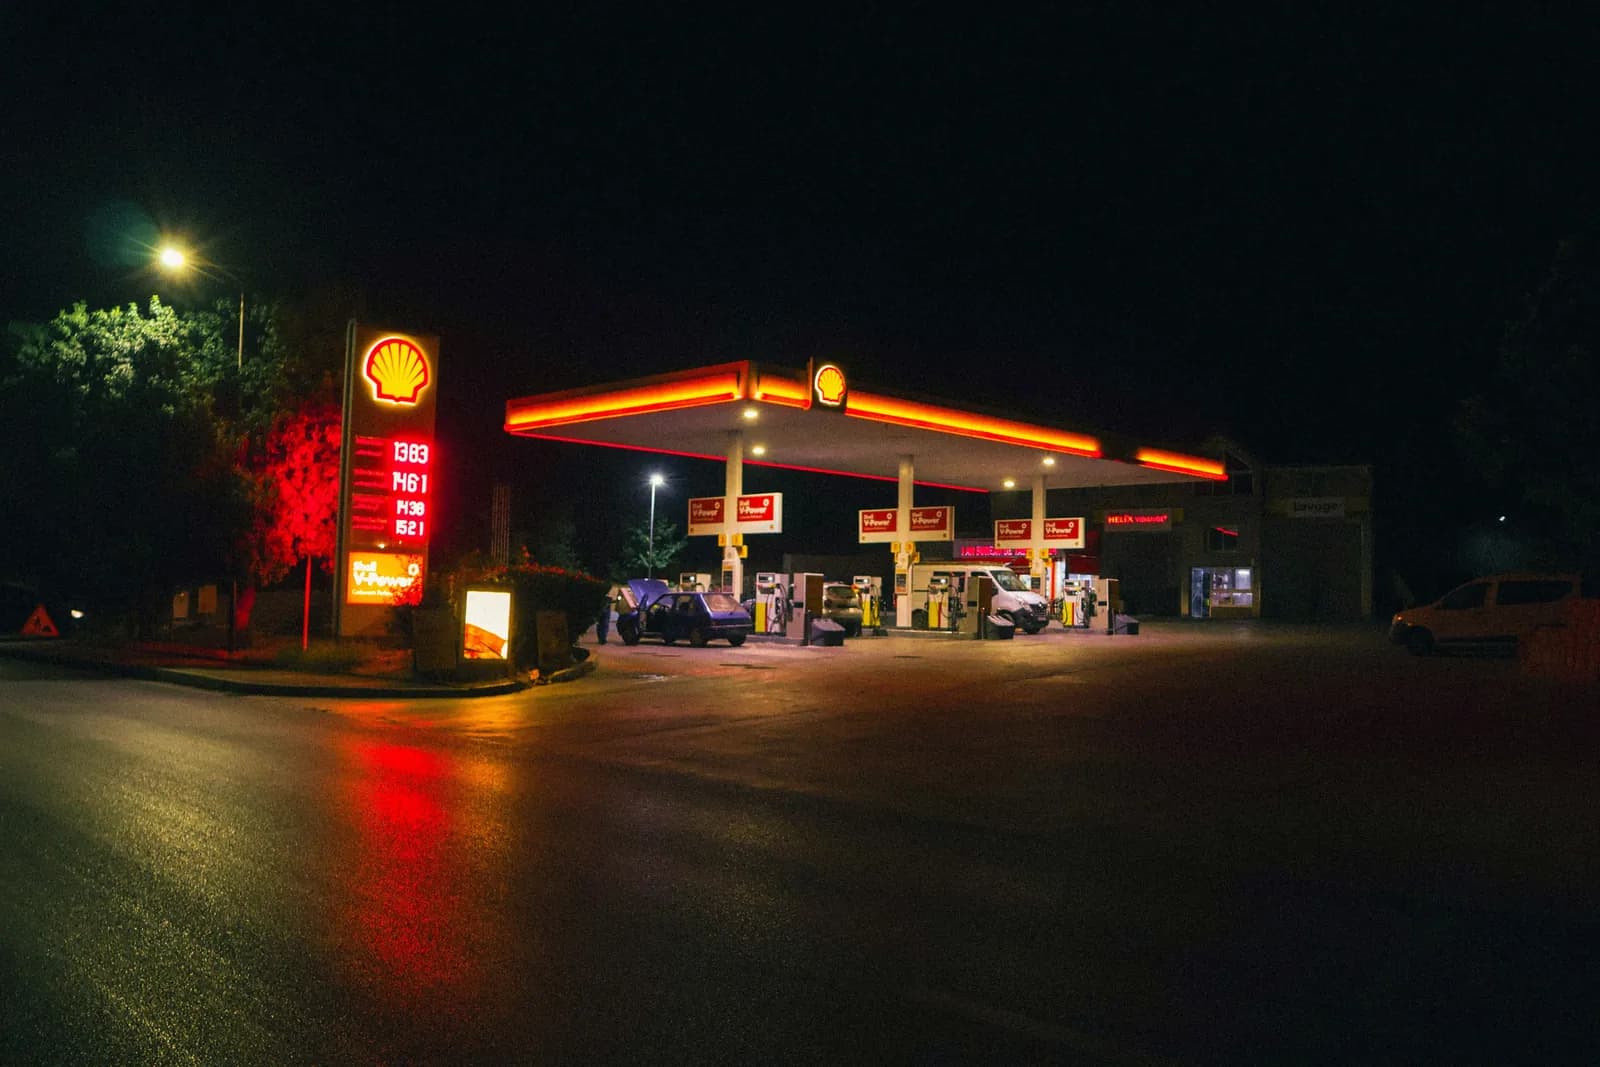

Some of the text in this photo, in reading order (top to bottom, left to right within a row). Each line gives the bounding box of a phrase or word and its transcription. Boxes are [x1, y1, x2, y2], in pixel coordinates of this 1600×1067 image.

[393, 441, 429, 464] 1383
[392, 471, 428, 494] 1461
[396, 499, 425, 517] 1438
[395, 519, 424, 536] 1521
[1107, 514, 1134, 525] HELIX
[352, 571, 415, 588] V-Power
